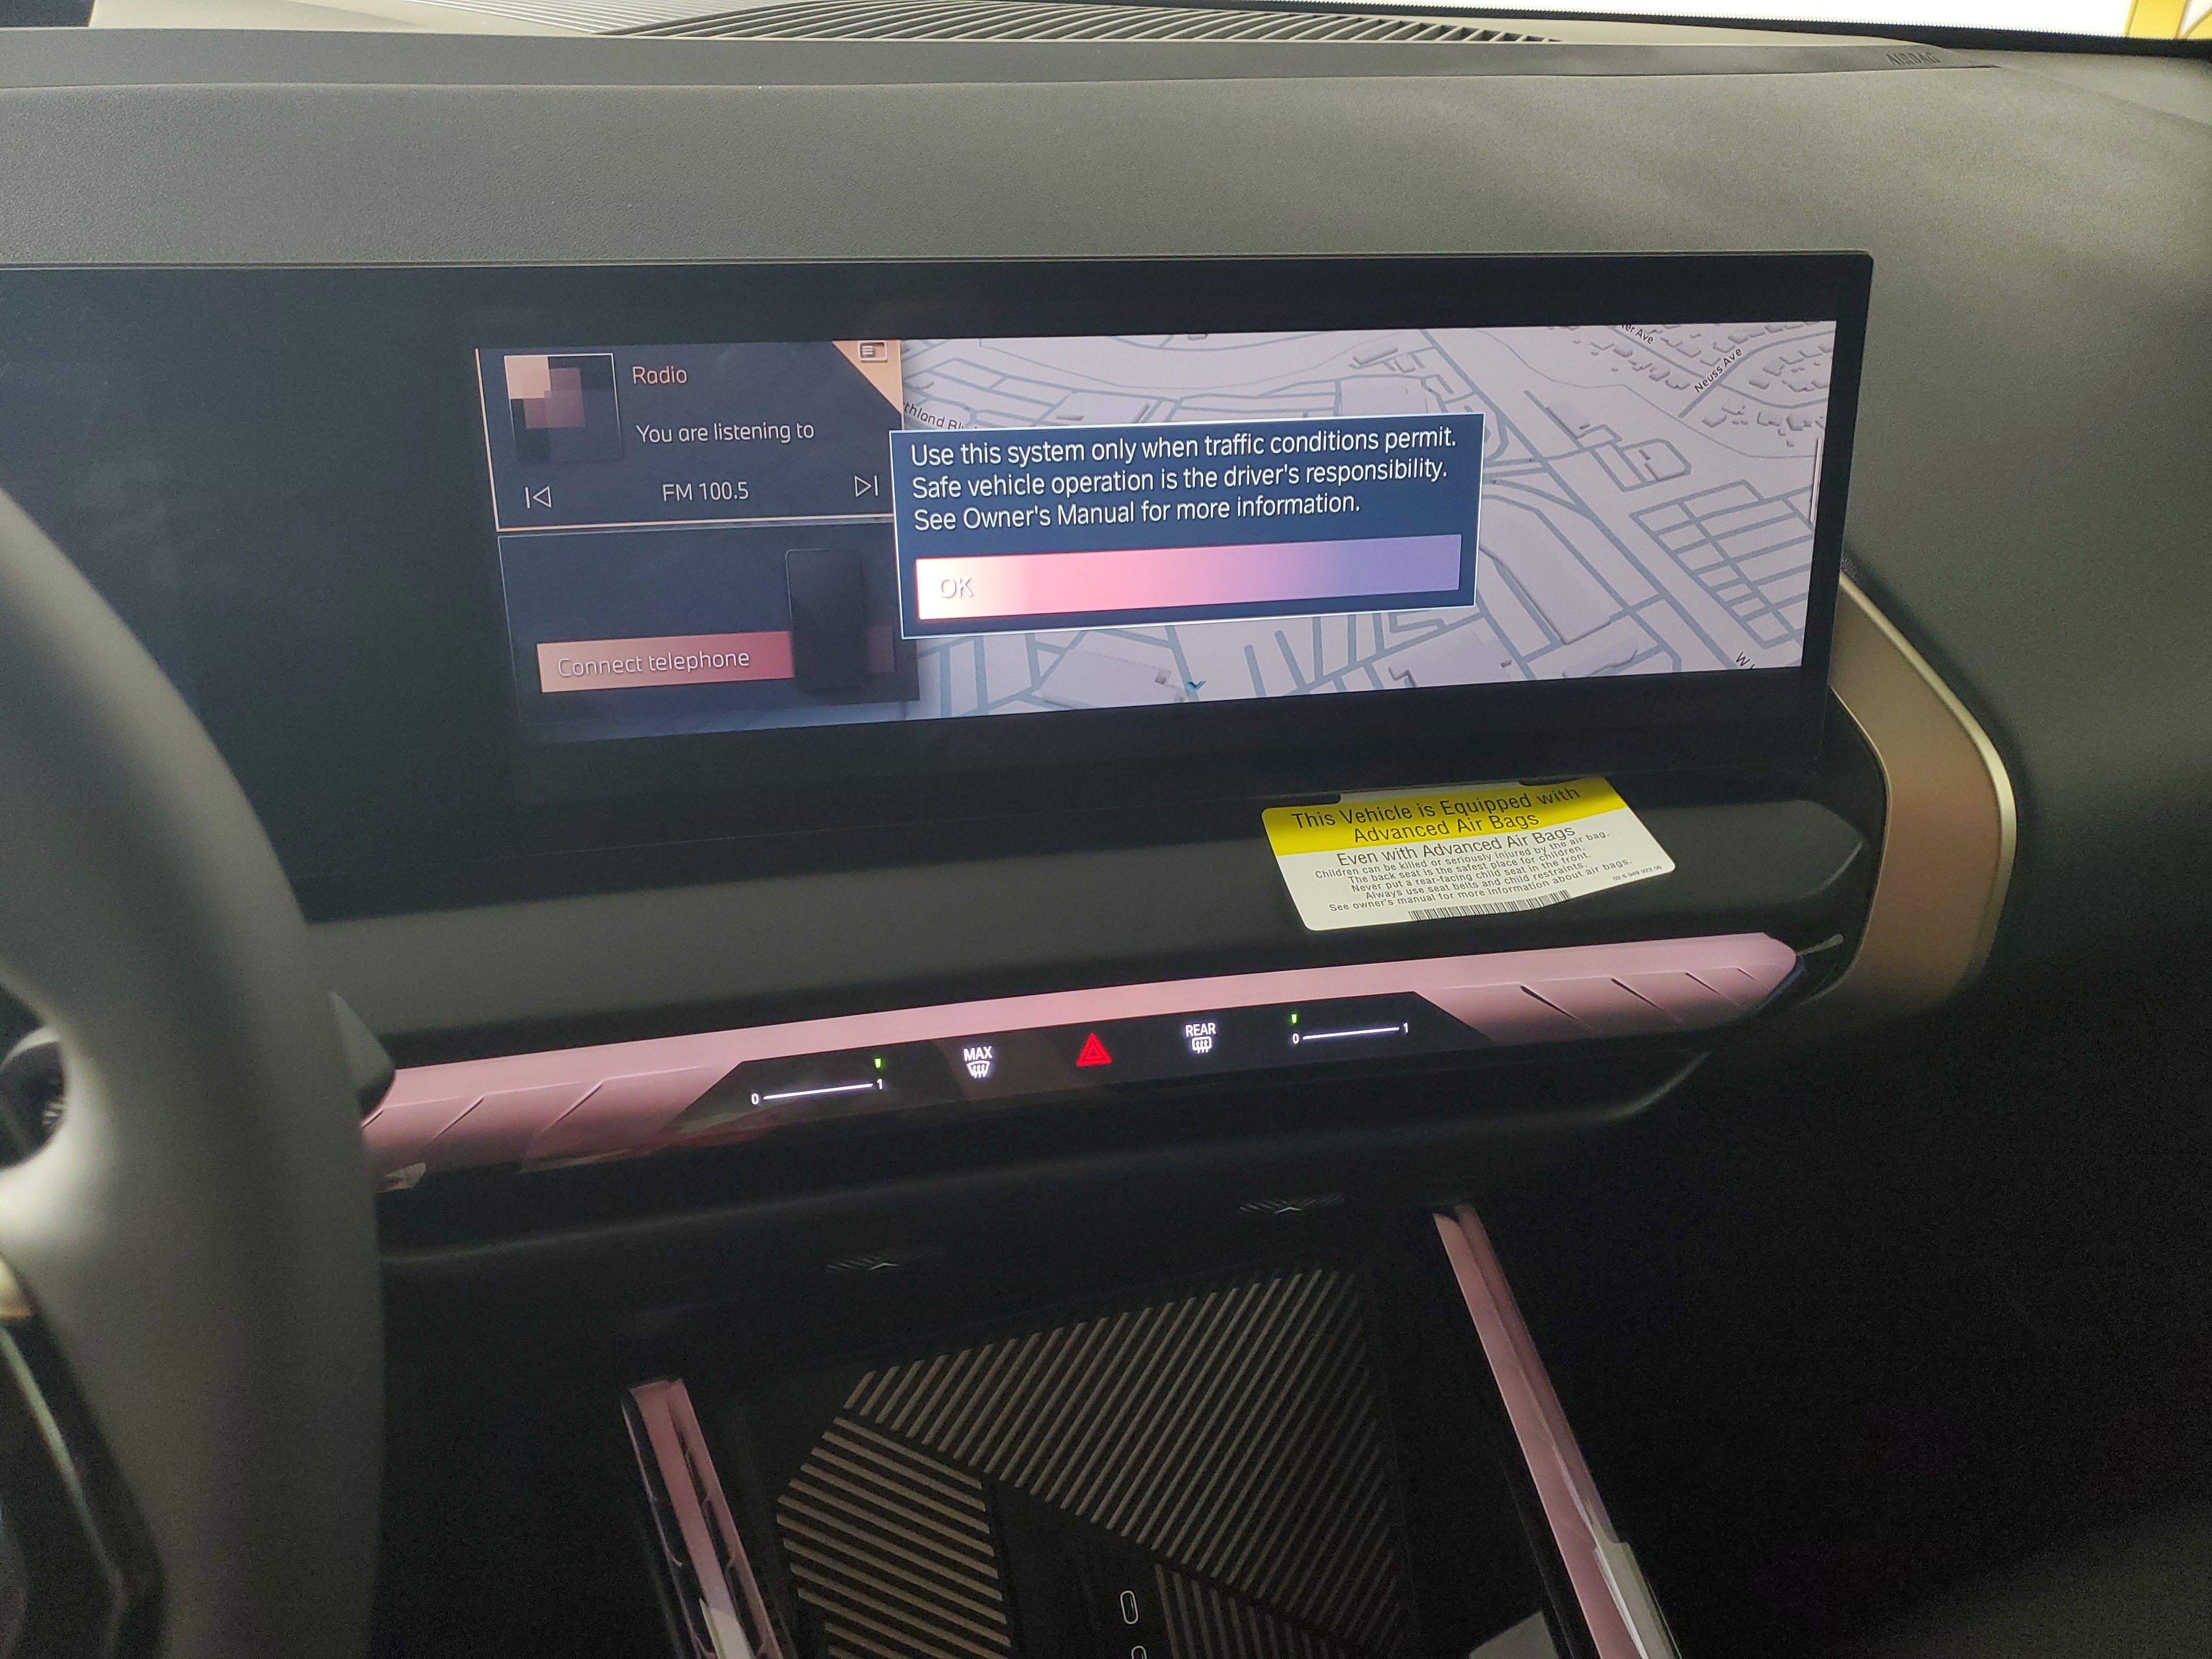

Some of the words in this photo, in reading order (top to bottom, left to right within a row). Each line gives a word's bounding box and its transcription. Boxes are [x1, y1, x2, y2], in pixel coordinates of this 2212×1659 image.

[1635, 329, 1654, 344] Ave
[633, 366, 688, 385] Radio
[1694, 365, 1723, 393] Neuss
[1723, 348, 1742, 367] Ave
[903, 400, 945, 428] thland
[636, 424, 672, 444] You
[679, 426, 708, 442] are
[714, 422, 792, 443] listening
[796, 422, 814, 439] to
[911, 444, 954, 466] Use
[961, 442, 1001, 464] this
[1008, 441, 1085, 467] system
[1092, 438, 1137, 464] only
[1142, 437, 1197, 458] when
[1204, 433, 1265, 456] traffic
[1271, 430, 1379, 453] conditions
[1385, 426, 1455, 453] permit.
[663, 484, 692, 501] FM
[698, 482, 749, 500] 100.5
[912, 476, 961, 499] Safe
[968, 473, 1045, 496] vehicle
[1051, 470, 1153, 498] operation
[1161, 468, 1177, 489] is
[1183, 467, 1217, 488] the
[1224, 464, 1299, 487] driver's
[1307, 458, 1447, 487] responsibility.
[914, 509, 956, 531] See
[963, 505, 1051, 529] Owner's
[1058, 500, 1134, 525] Manual
[1142, 500, 1171, 522] for
[1177, 501, 1230, 520] more
[1237, 492, 1359, 517] information.
[940, 575, 974, 599] OK
[557, 656, 642, 677] Connect
[648, 651, 750, 673] telephone
[1291, 812, 1335, 828] This
[1339, 805, 1412, 823] Vehicle
[1417, 803, 1435, 817] is
[1440, 794, 1532, 815] Equipped
[1536, 788, 1580, 804] with
[1355, 820, 1450, 843] Advanced
[1457, 817, 1482, 833] Air
[1488, 815, 1539, 829] Bags
[1316, 869, 1359, 878] Children
[1363, 866, 1380, 874] can
[1399, 860, 1427, 870] killed
[1445, 853, 1492, 865] seriously
[1496, 848, 1531, 859] injured
[1549, 842, 1567, 850] the
[1586, 832, 1609, 840] bag.
[1337, 853, 1378, 866] Even
[1381, 846, 1418, 861] with
[1423, 837, 1502, 857] Advanced
[1507, 835, 1528, 848] Air
[1532, 827, 1575, 844] Bags
[1351, 883, 1381, 893] Never
[1386, 881, 1403, 890] put
[1415, 873, 1472, 886] rear-facing
[1476, 870, 1501, 879] child
[1504, 866, 1526, 875] seat
[1530, 864, 1539, 872] in
[1542, 860, 1559, 869] the
[1561, 851, 1592, 864] front.
[1372, 873, 1395, 882] back
[1399, 870, 1420, 878] seat
[1456, 862, 1488, 872] safest
[1491, 859, 1518, 870] place
[1539, 845, 1585, 861] children.
[1353, 898, 1393, 909] owner's
[1397, 894, 1435, 905] manual
[1438, 891, 1454, 900] for
[1458, 890, 1485, 898] more
[1487, 880, 1550, 895] information
[1553, 871, 1583, 884] about
[1586, 866, 1599, 875] air
[1602, 859, 1632, 870] bags.
[1366, 889, 1403, 899] Always
[1428, 884, 1449, 893] seat
[1452, 882, 1479, 890] belts
[1482, 878, 1501, 887] and
[1505, 874, 1530, 884] child
[1533, 863, 1587, 879] restraints.
[1186, 1022, 1216, 1037] REAR
[1403, 1023, 1409, 1034] 1
[963, 1046, 992, 1062] MAX
[877, 1079, 883, 1090] 1
